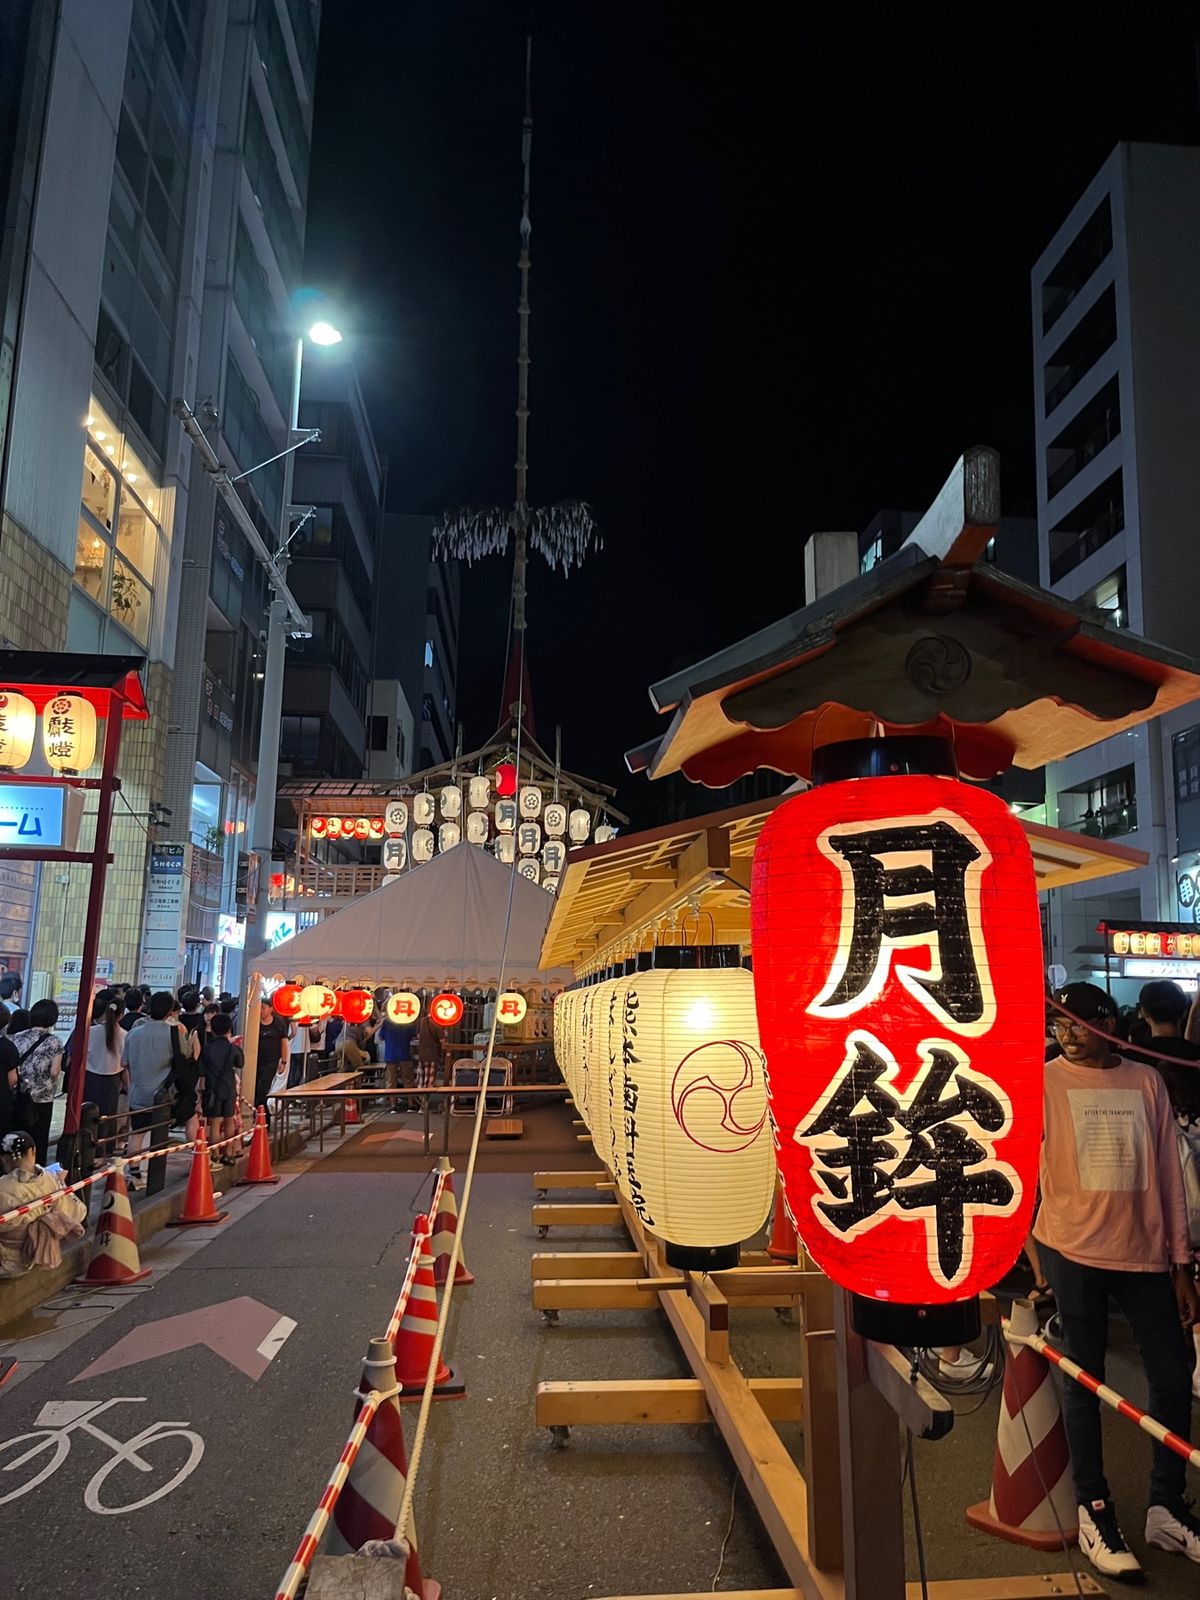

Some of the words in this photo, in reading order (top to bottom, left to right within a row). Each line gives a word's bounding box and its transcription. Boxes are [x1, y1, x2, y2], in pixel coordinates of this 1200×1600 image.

[521, 827, 538, 851] 月
[385, 842, 405, 867] 月
[545, 846, 561, 870] 月
[393, 999, 415, 1017] 月
[500, 999, 521, 1017] 月
[798, 814, 1019, 1284] 月鉾
